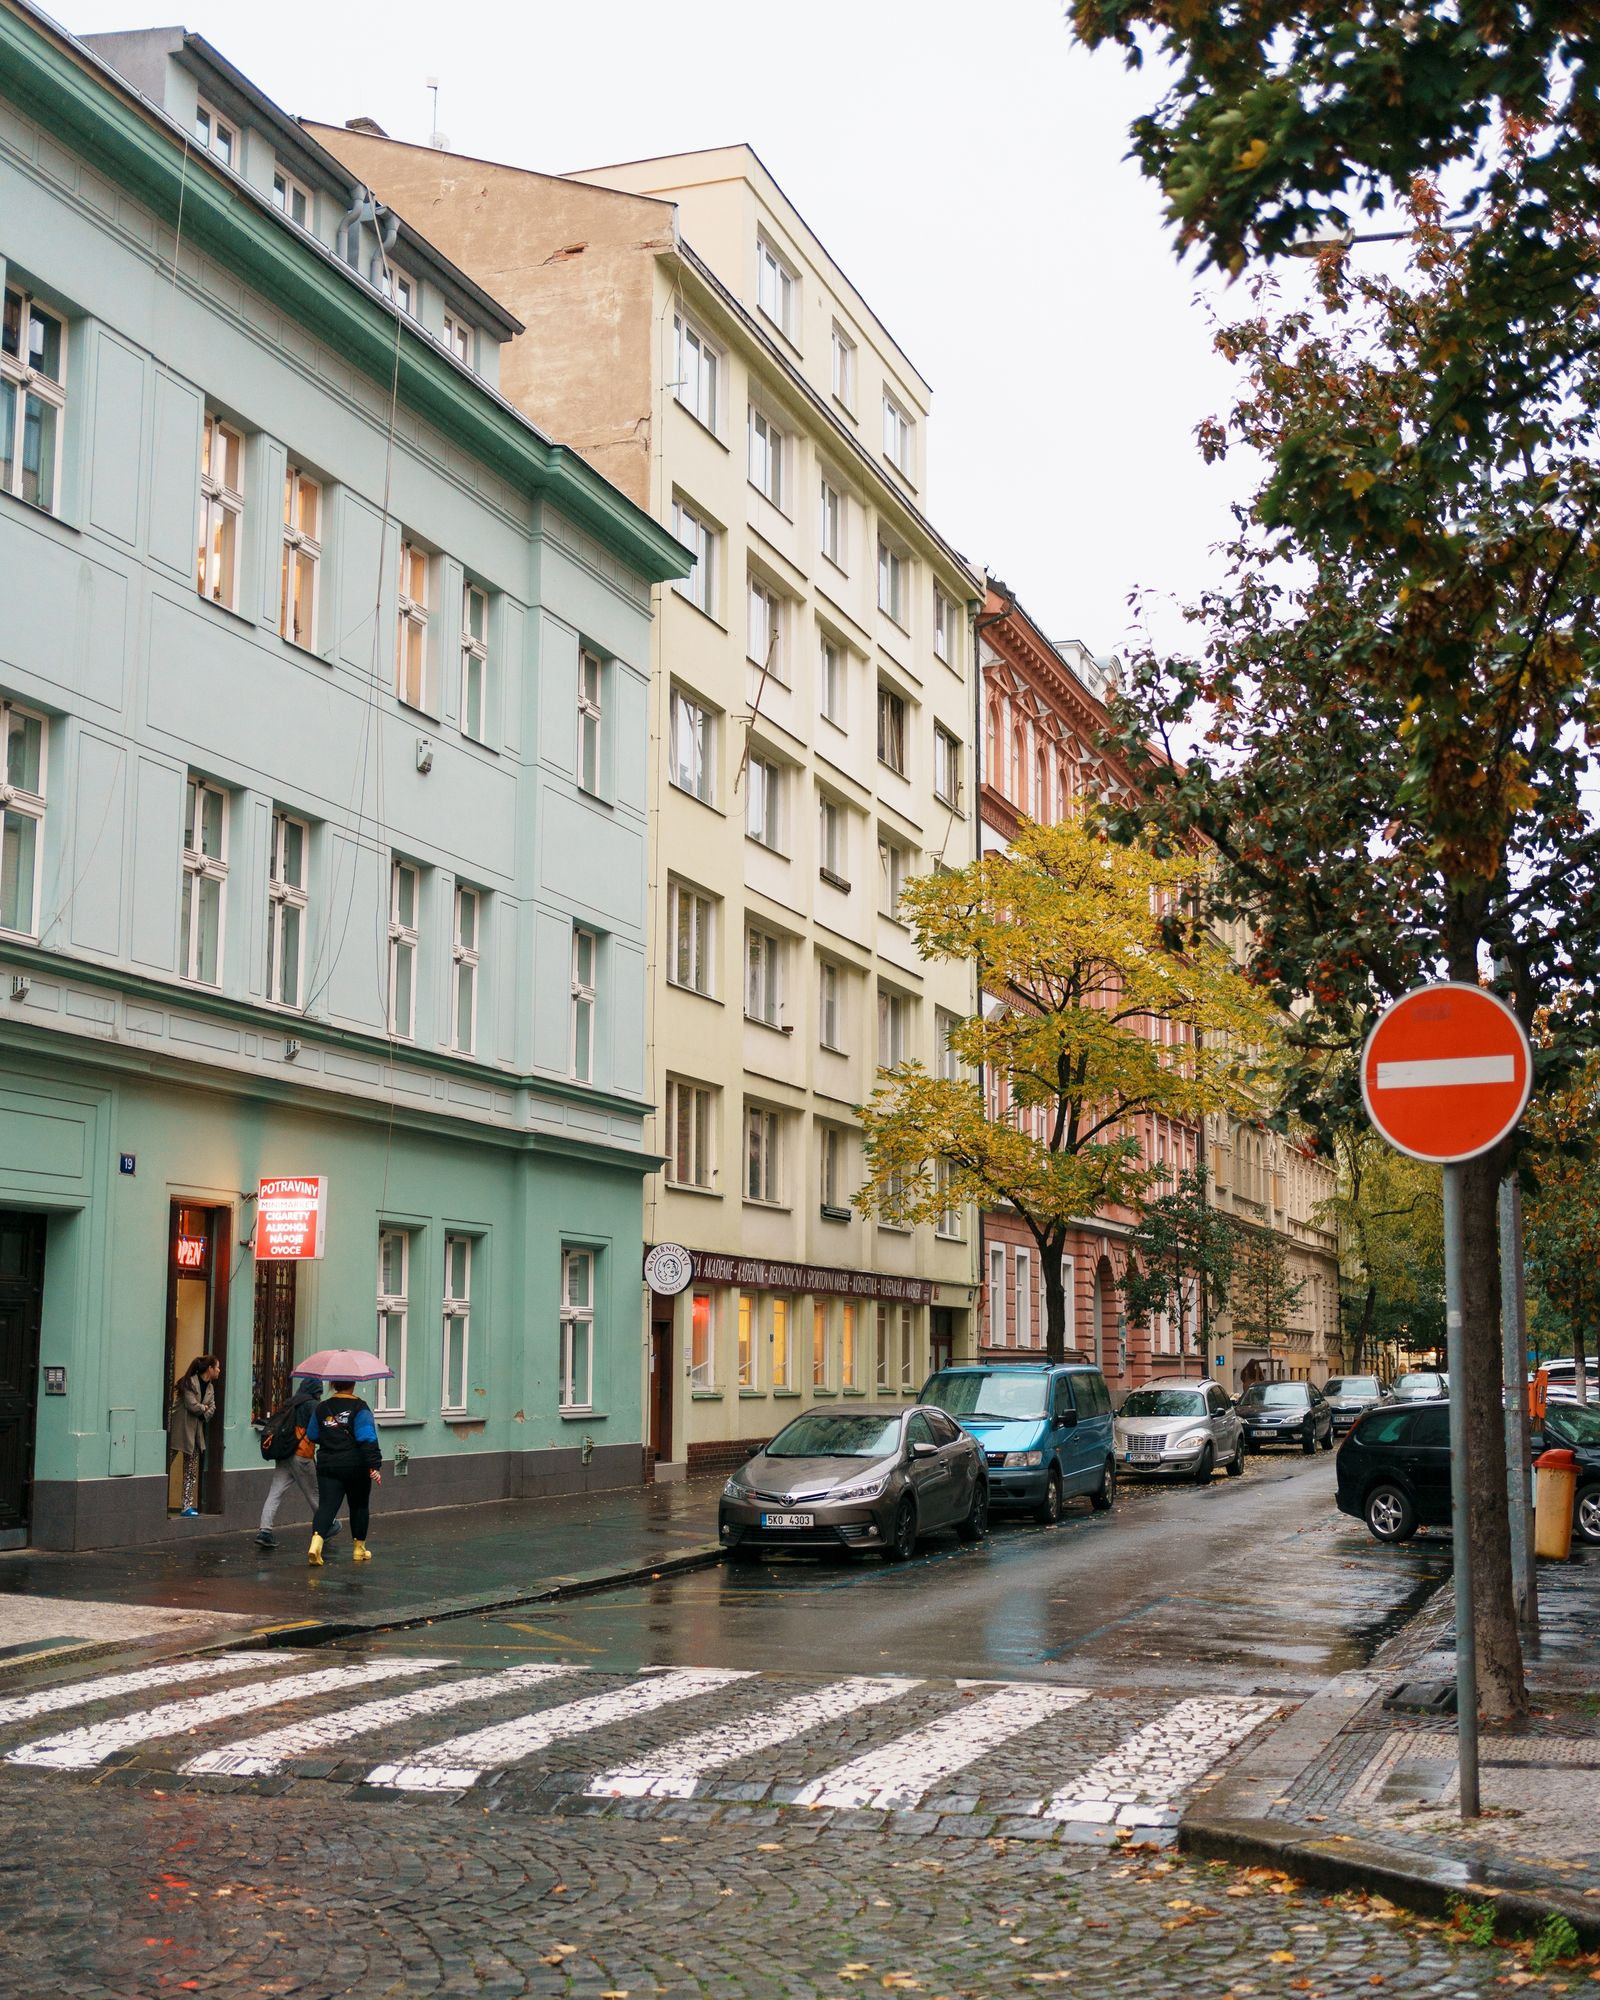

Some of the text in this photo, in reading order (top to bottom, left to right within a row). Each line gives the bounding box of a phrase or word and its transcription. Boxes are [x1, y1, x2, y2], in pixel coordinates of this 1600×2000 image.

[124, 1157, 133, 1170] 19
[260, 1180, 318, 1198] POTRAVINY
[261, 1200, 316, 1208] MINIMARKET
[265, 1211, 311, 1221] CIGARETY
[265, 1223, 309, 1232] ALKOHOL
[269, 1232, 305, 1245] NÁPOJE
[270, 1246, 302, 1255] OVOCE
[703, 1257, 734, 1281] AKADEMIE
[789, 1515, 810, 1525] 4303
